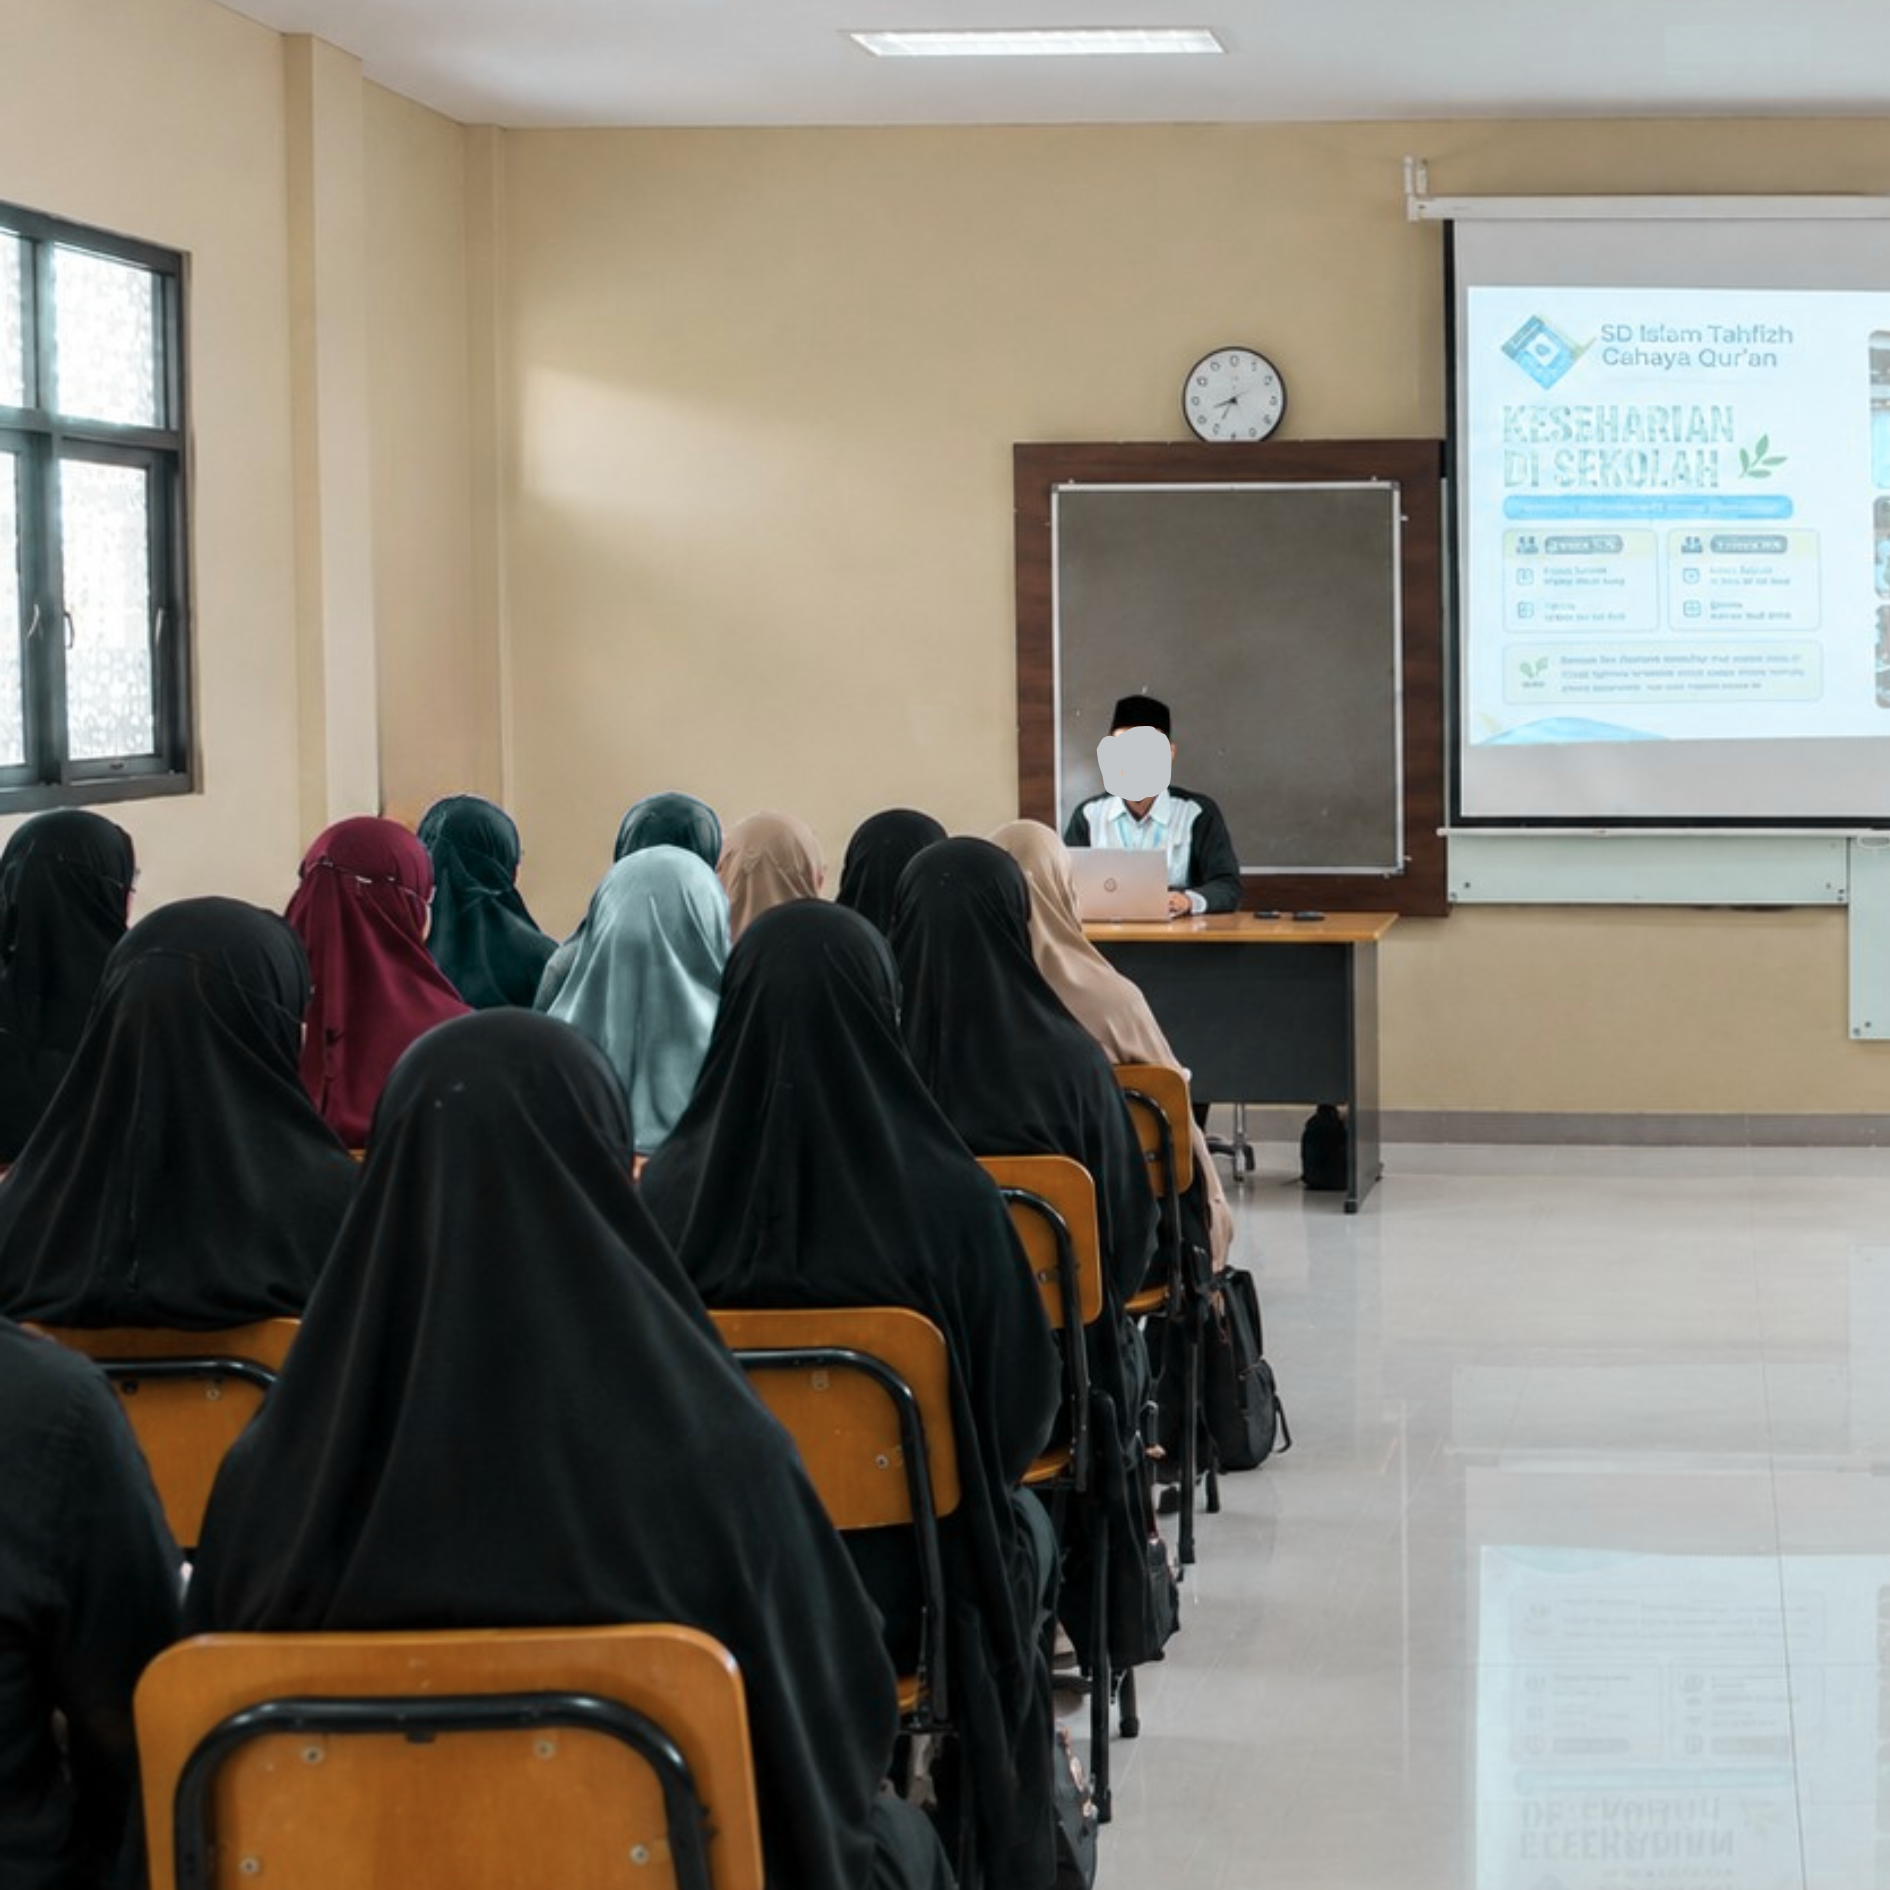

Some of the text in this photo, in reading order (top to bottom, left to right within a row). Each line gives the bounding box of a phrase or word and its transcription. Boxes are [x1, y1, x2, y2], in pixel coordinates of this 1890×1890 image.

[1601, 324, 1793, 343] SD Islam Tahfizh
[1602, 348, 1777, 371] Cahaya Qur'an
[1502, 405, 1734, 443] KESEHARIAN
[1504, 449, 1720, 488] DI SEKOLAH
